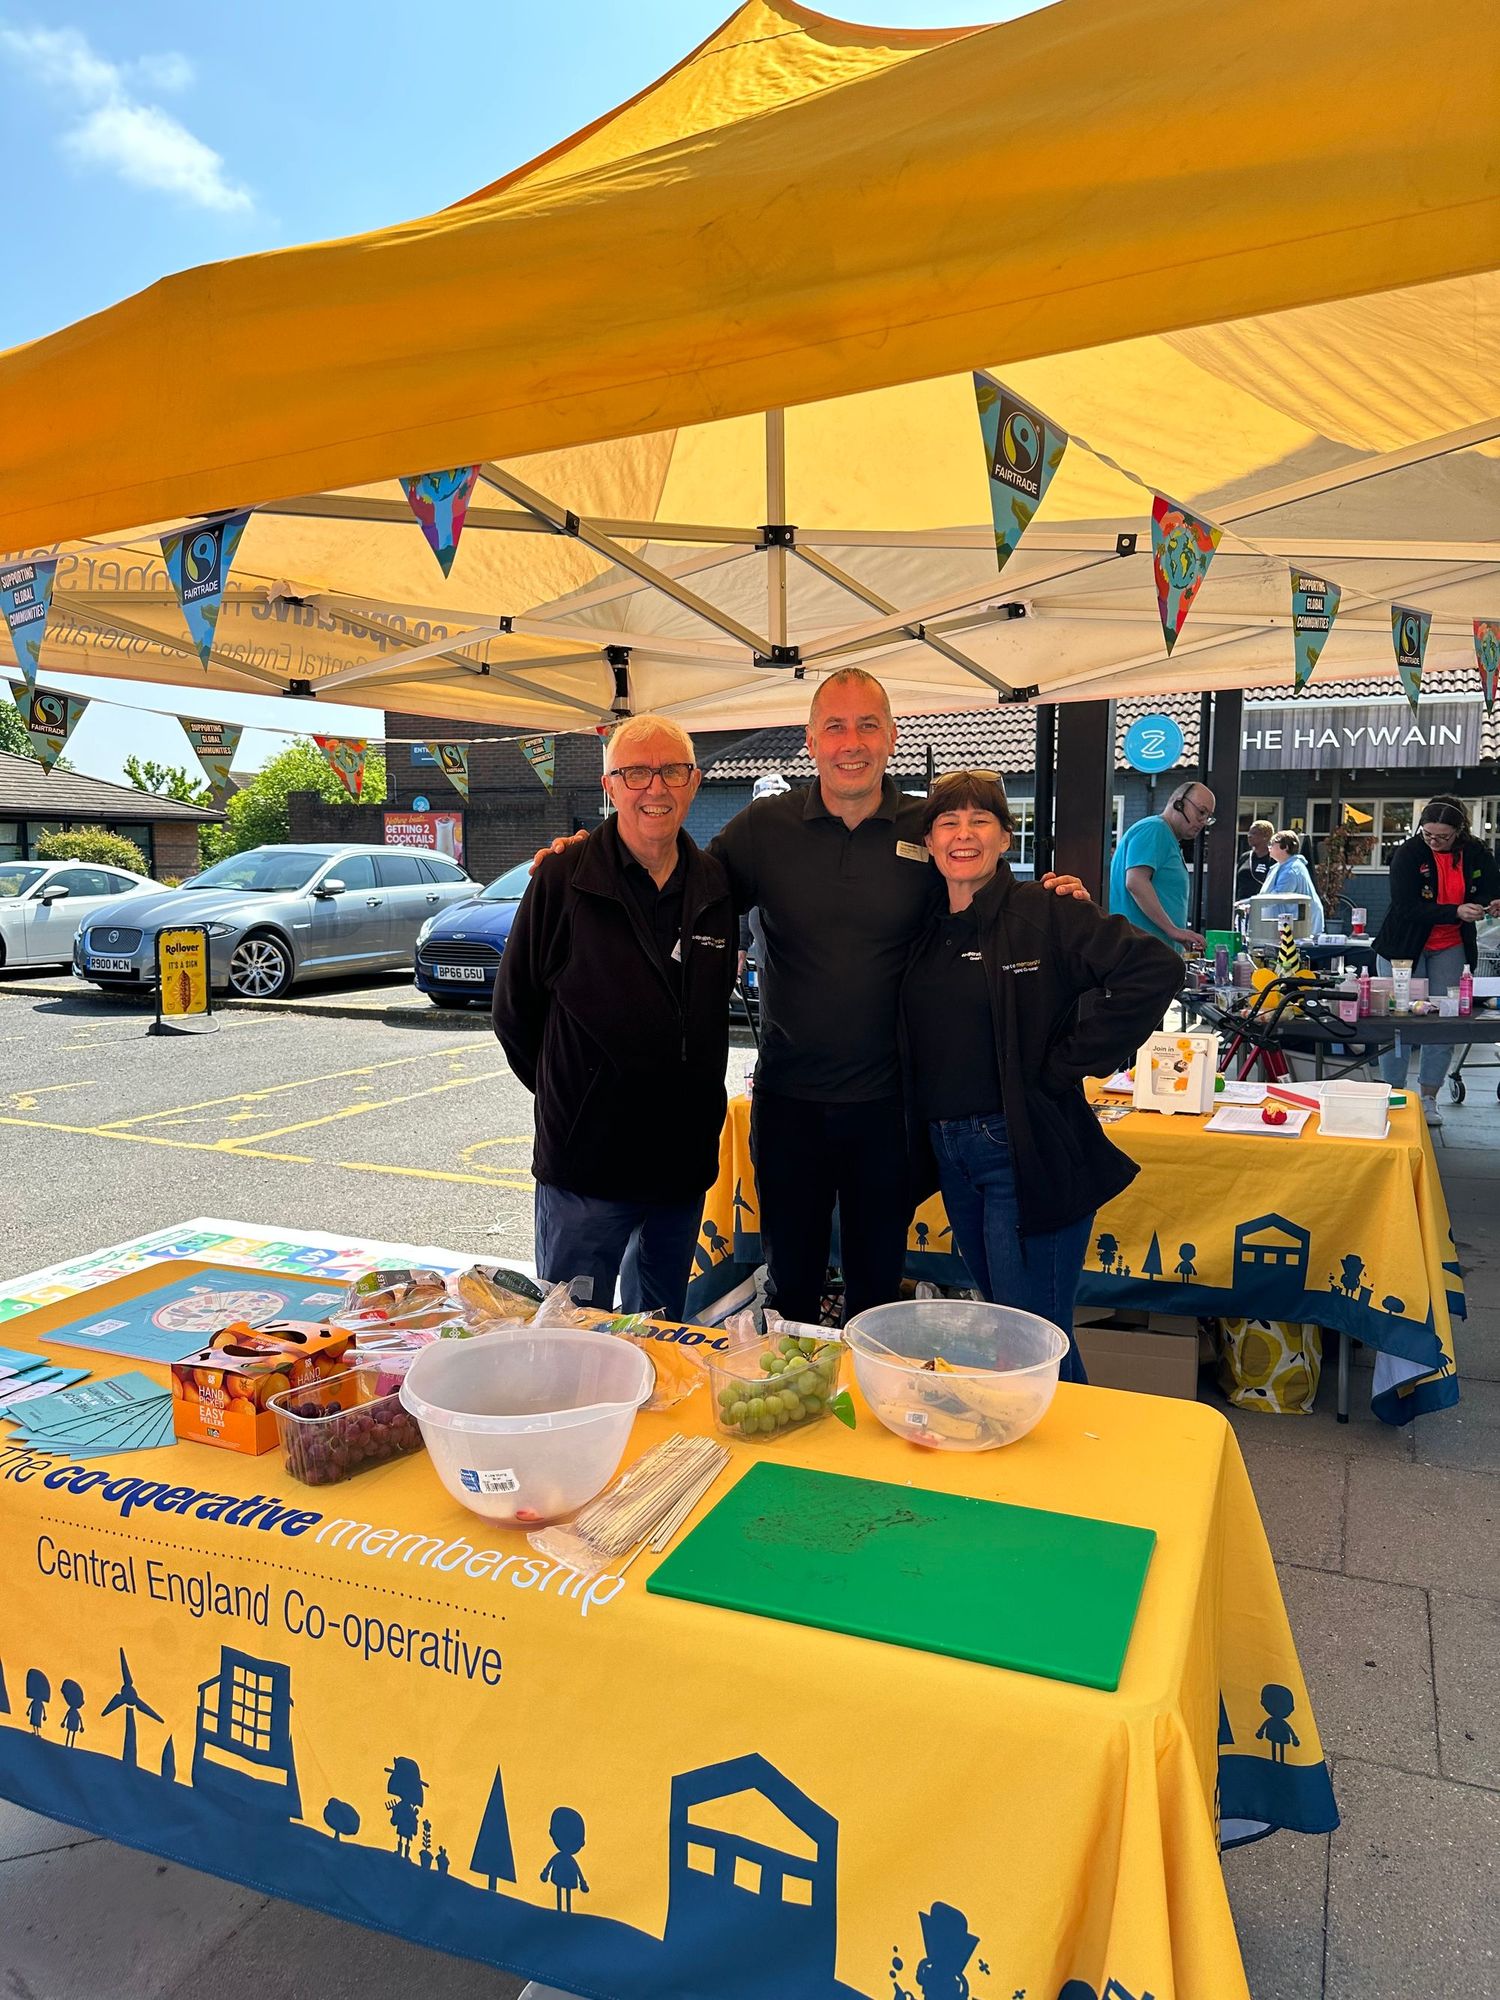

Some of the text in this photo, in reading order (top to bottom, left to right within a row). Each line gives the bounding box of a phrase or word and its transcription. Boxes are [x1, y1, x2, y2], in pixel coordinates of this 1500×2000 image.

[995, 464, 1038, 494] FAIRTRADE
[1, 566, 34, 588] SUPPORTING
[184, 580, 218, 600] FAIRTRADE
[1299, 578, 1326, 592] SUPPORTING
[14, 589, 34, 605] GLOBAL
[1306, 598, 1323, 610] GLOBAL
[9, 604, 45, 627] COMMUNITIES
[1296, 616, 1330, 629] COMMUNITIES
[31, 723, 65, 736] FAIRTRADE
[191, 723, 222, 733] SUPPORTING
[202, 735, 221, 744] GLOBAL
[1242, 725, 1462, 750] HE HAYWAIN
[386, 824, 430, 834] GETTING 2
[386, 835, 434, 844] COCKTAILS
[165, 943, 199, 955] Rollover
[91, 958, 111, 969] R900
[168, 961, 179, 970] IT'S
[186, 960, 198, 969] SIGN
[439, 967, 483, 979] BP66 GSU
[297, 1367, 321, 1386] HAND
[199, 1386, 224, 1400] HAND
[199, 1395, 225, 1409] PICKED
[200, 1406, 225, 1420] EASY
[200, 1416, 225, 1427] PEELERS
[0, 1446, 52, 1482] The
[44, 1465, 322, 1536] co-operative
[37, 1536, 502, 1685] Central England Co-operative
